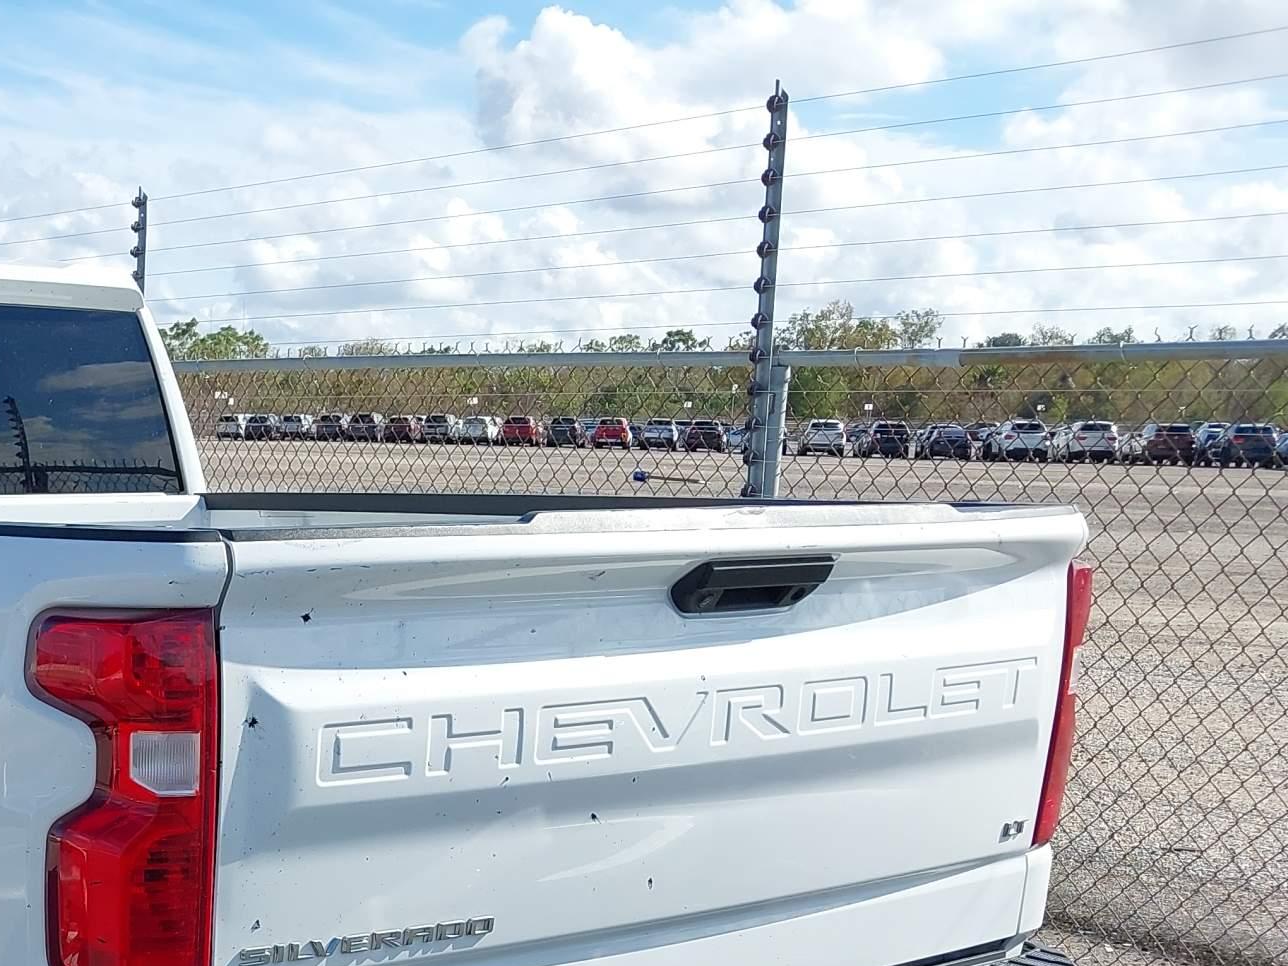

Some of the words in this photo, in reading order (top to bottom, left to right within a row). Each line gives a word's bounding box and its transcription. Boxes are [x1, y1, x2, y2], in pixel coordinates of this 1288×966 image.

[317, 657, 1037, 785] CHEVROLET
[1000, 819, 1029, 838] LT
[239, 916, 495, 966] SILVERADO
